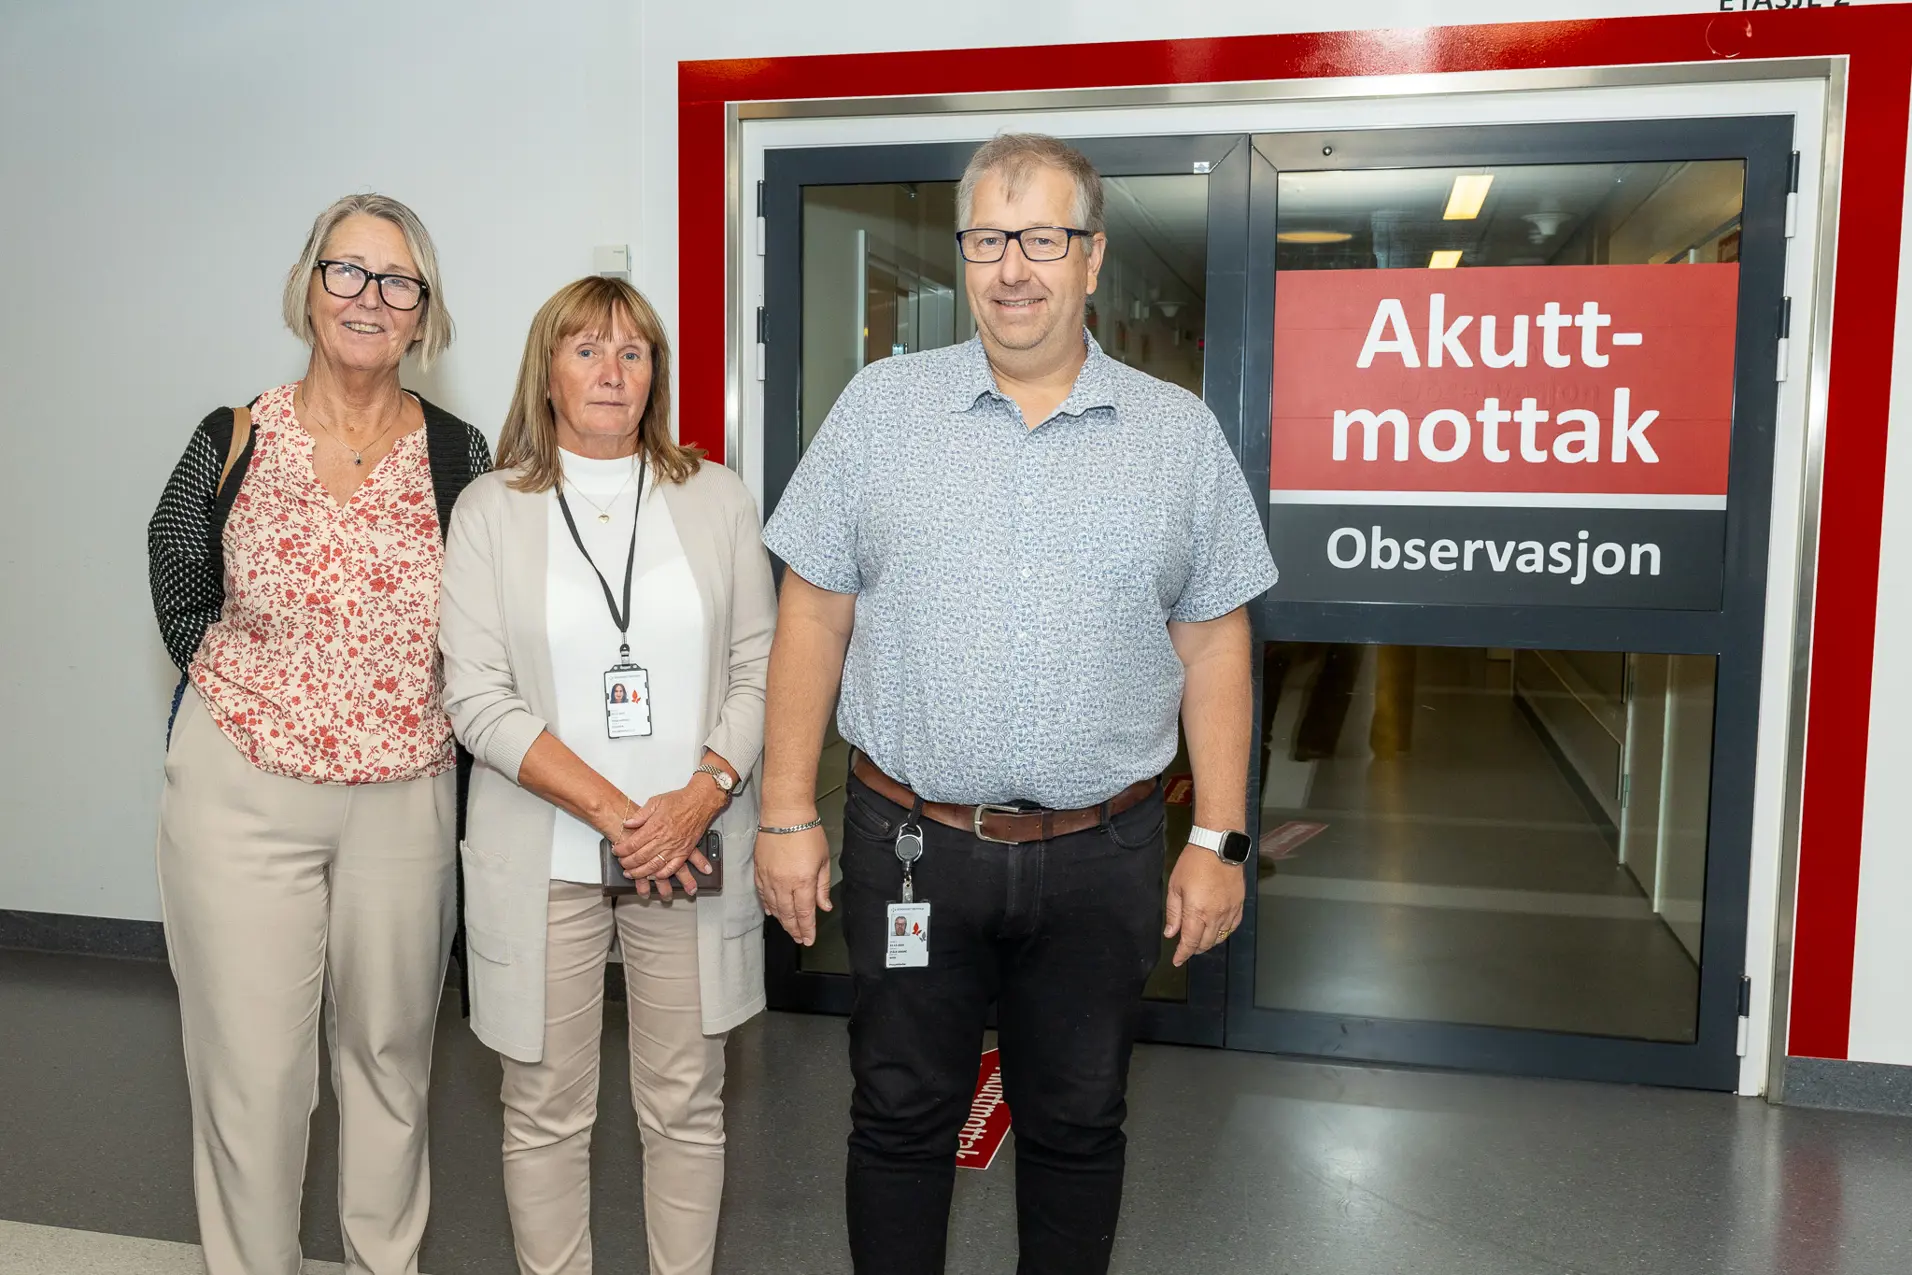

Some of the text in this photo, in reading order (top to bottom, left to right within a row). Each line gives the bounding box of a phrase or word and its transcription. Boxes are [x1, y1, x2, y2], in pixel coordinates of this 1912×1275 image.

[1356, 292, 1643, 369] Akutt-
[1332, 387, 1660, 464] mottak
[1326, 525, 1661, 585] Observasjon
[955, 1066, 1005, 1159] uttmottak
